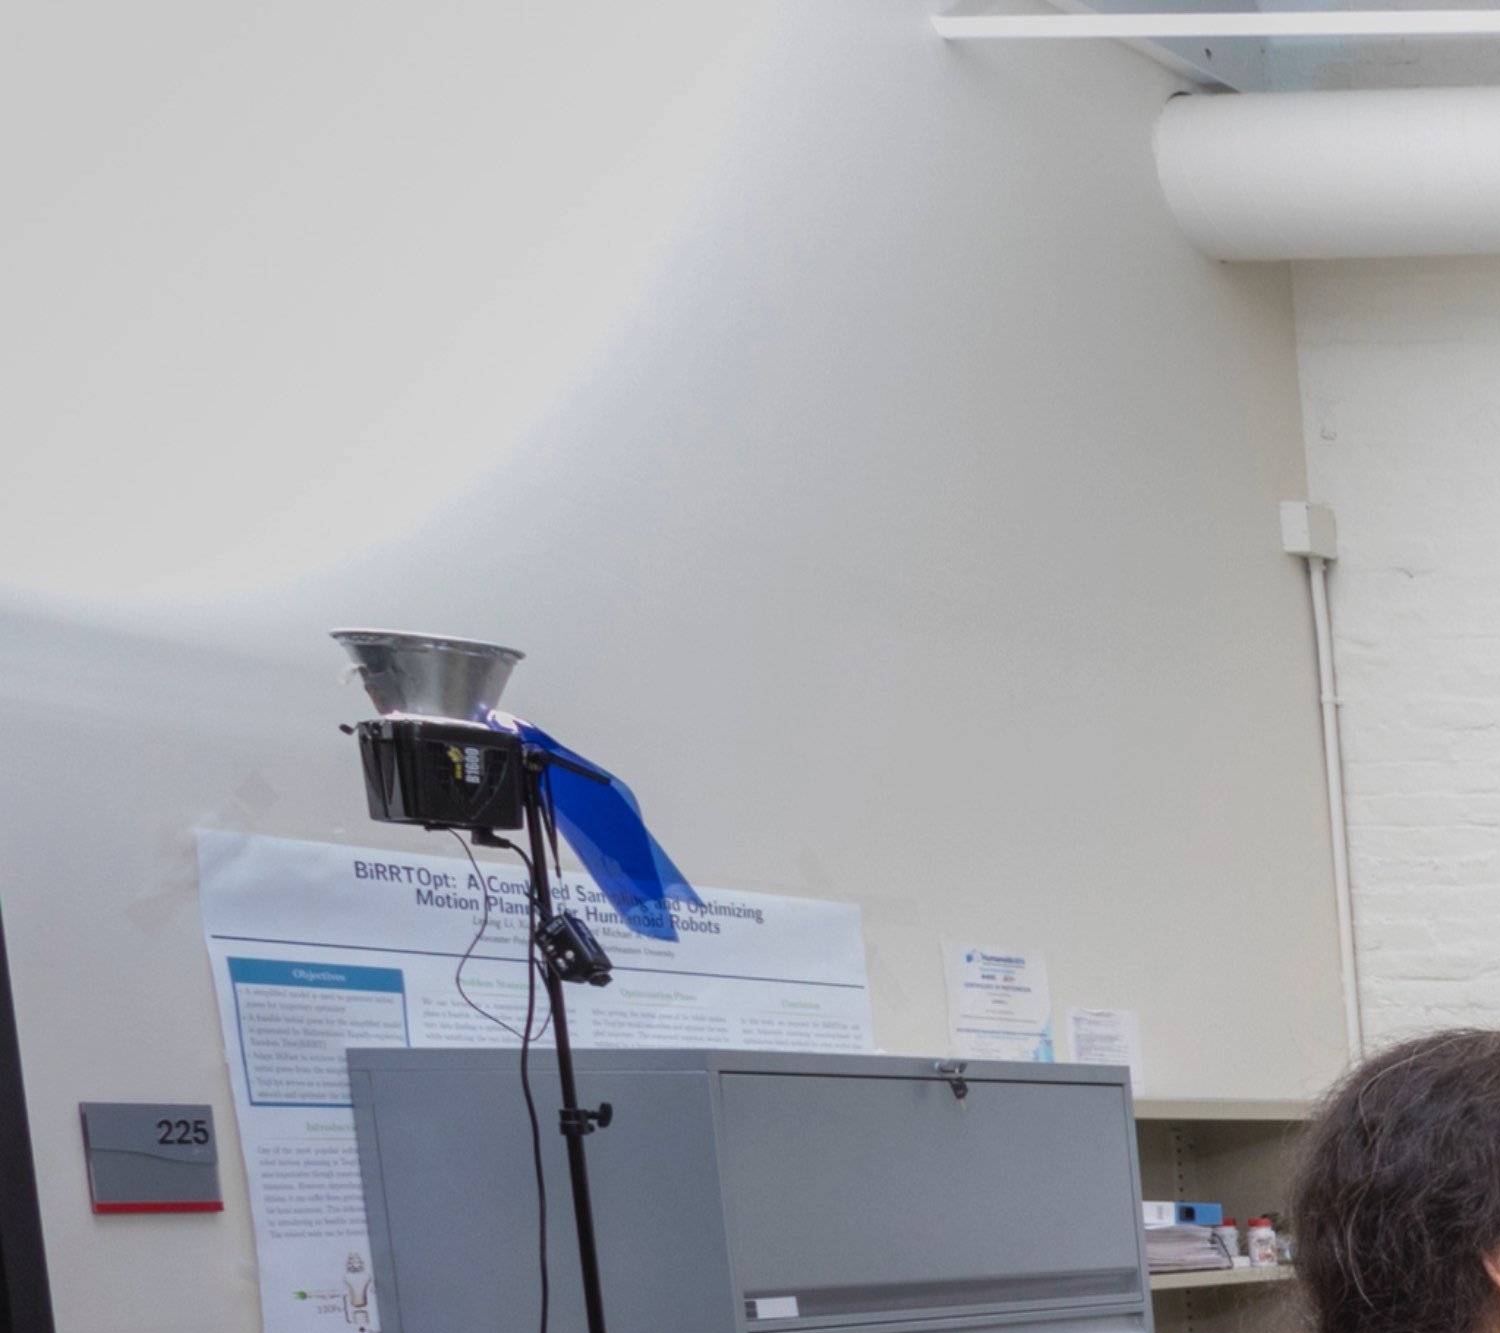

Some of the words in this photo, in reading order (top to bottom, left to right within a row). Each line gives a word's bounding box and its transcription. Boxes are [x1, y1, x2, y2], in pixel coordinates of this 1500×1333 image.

[354, 860, 457, 890] BiRRTOpt:
[467, 873, 481, 891] A
[487, 875, 570, 900] Comed
[687, 897, 765, 924] Optimizing
[415, 887, 480, 911] Motion
[670, 914, 721, 934] Robots
[292, 967, 346, 983] Objectives
[156, 1119, 210, 1146] 225
